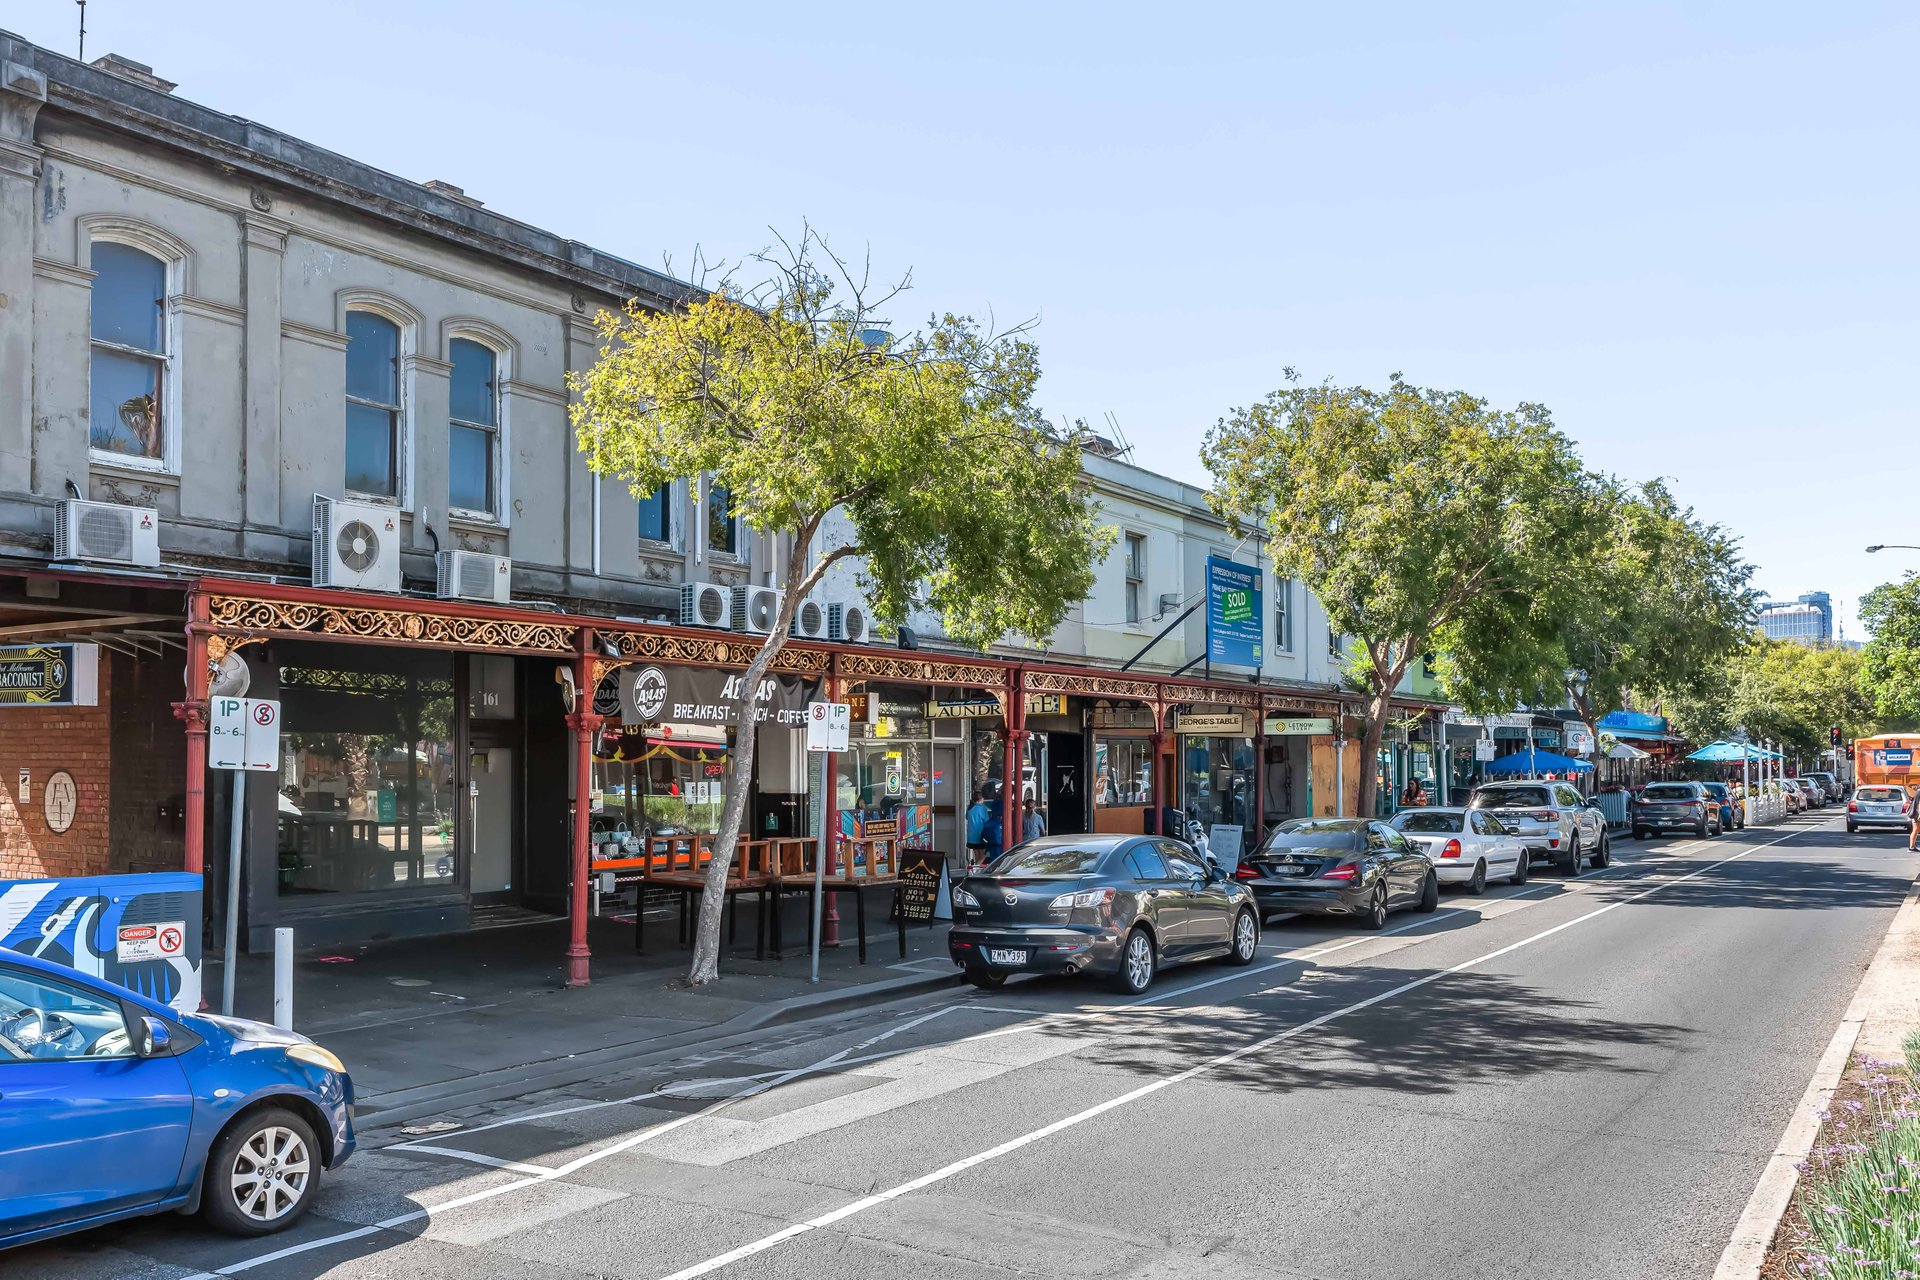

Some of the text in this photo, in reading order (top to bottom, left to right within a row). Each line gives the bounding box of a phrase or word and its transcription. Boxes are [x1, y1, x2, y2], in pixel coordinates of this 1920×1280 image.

[1228, 592, 1246, 608] SOLD
[483, 692, 499, 706] 161
[220, 700, 240, 717] 1P
[673, 703, 730, 720] BREAKFAST
[777, 709, 809, 723] COFFE
[834, 706, 846, 717] 1P
[1179, 717, 1239, 726] GEORGE'S TABLE
[704, 765, 725, 776] OPEN
[124, 930, 151, 938] DANGER
[992, 951, 1026, 961] ZMN 395
